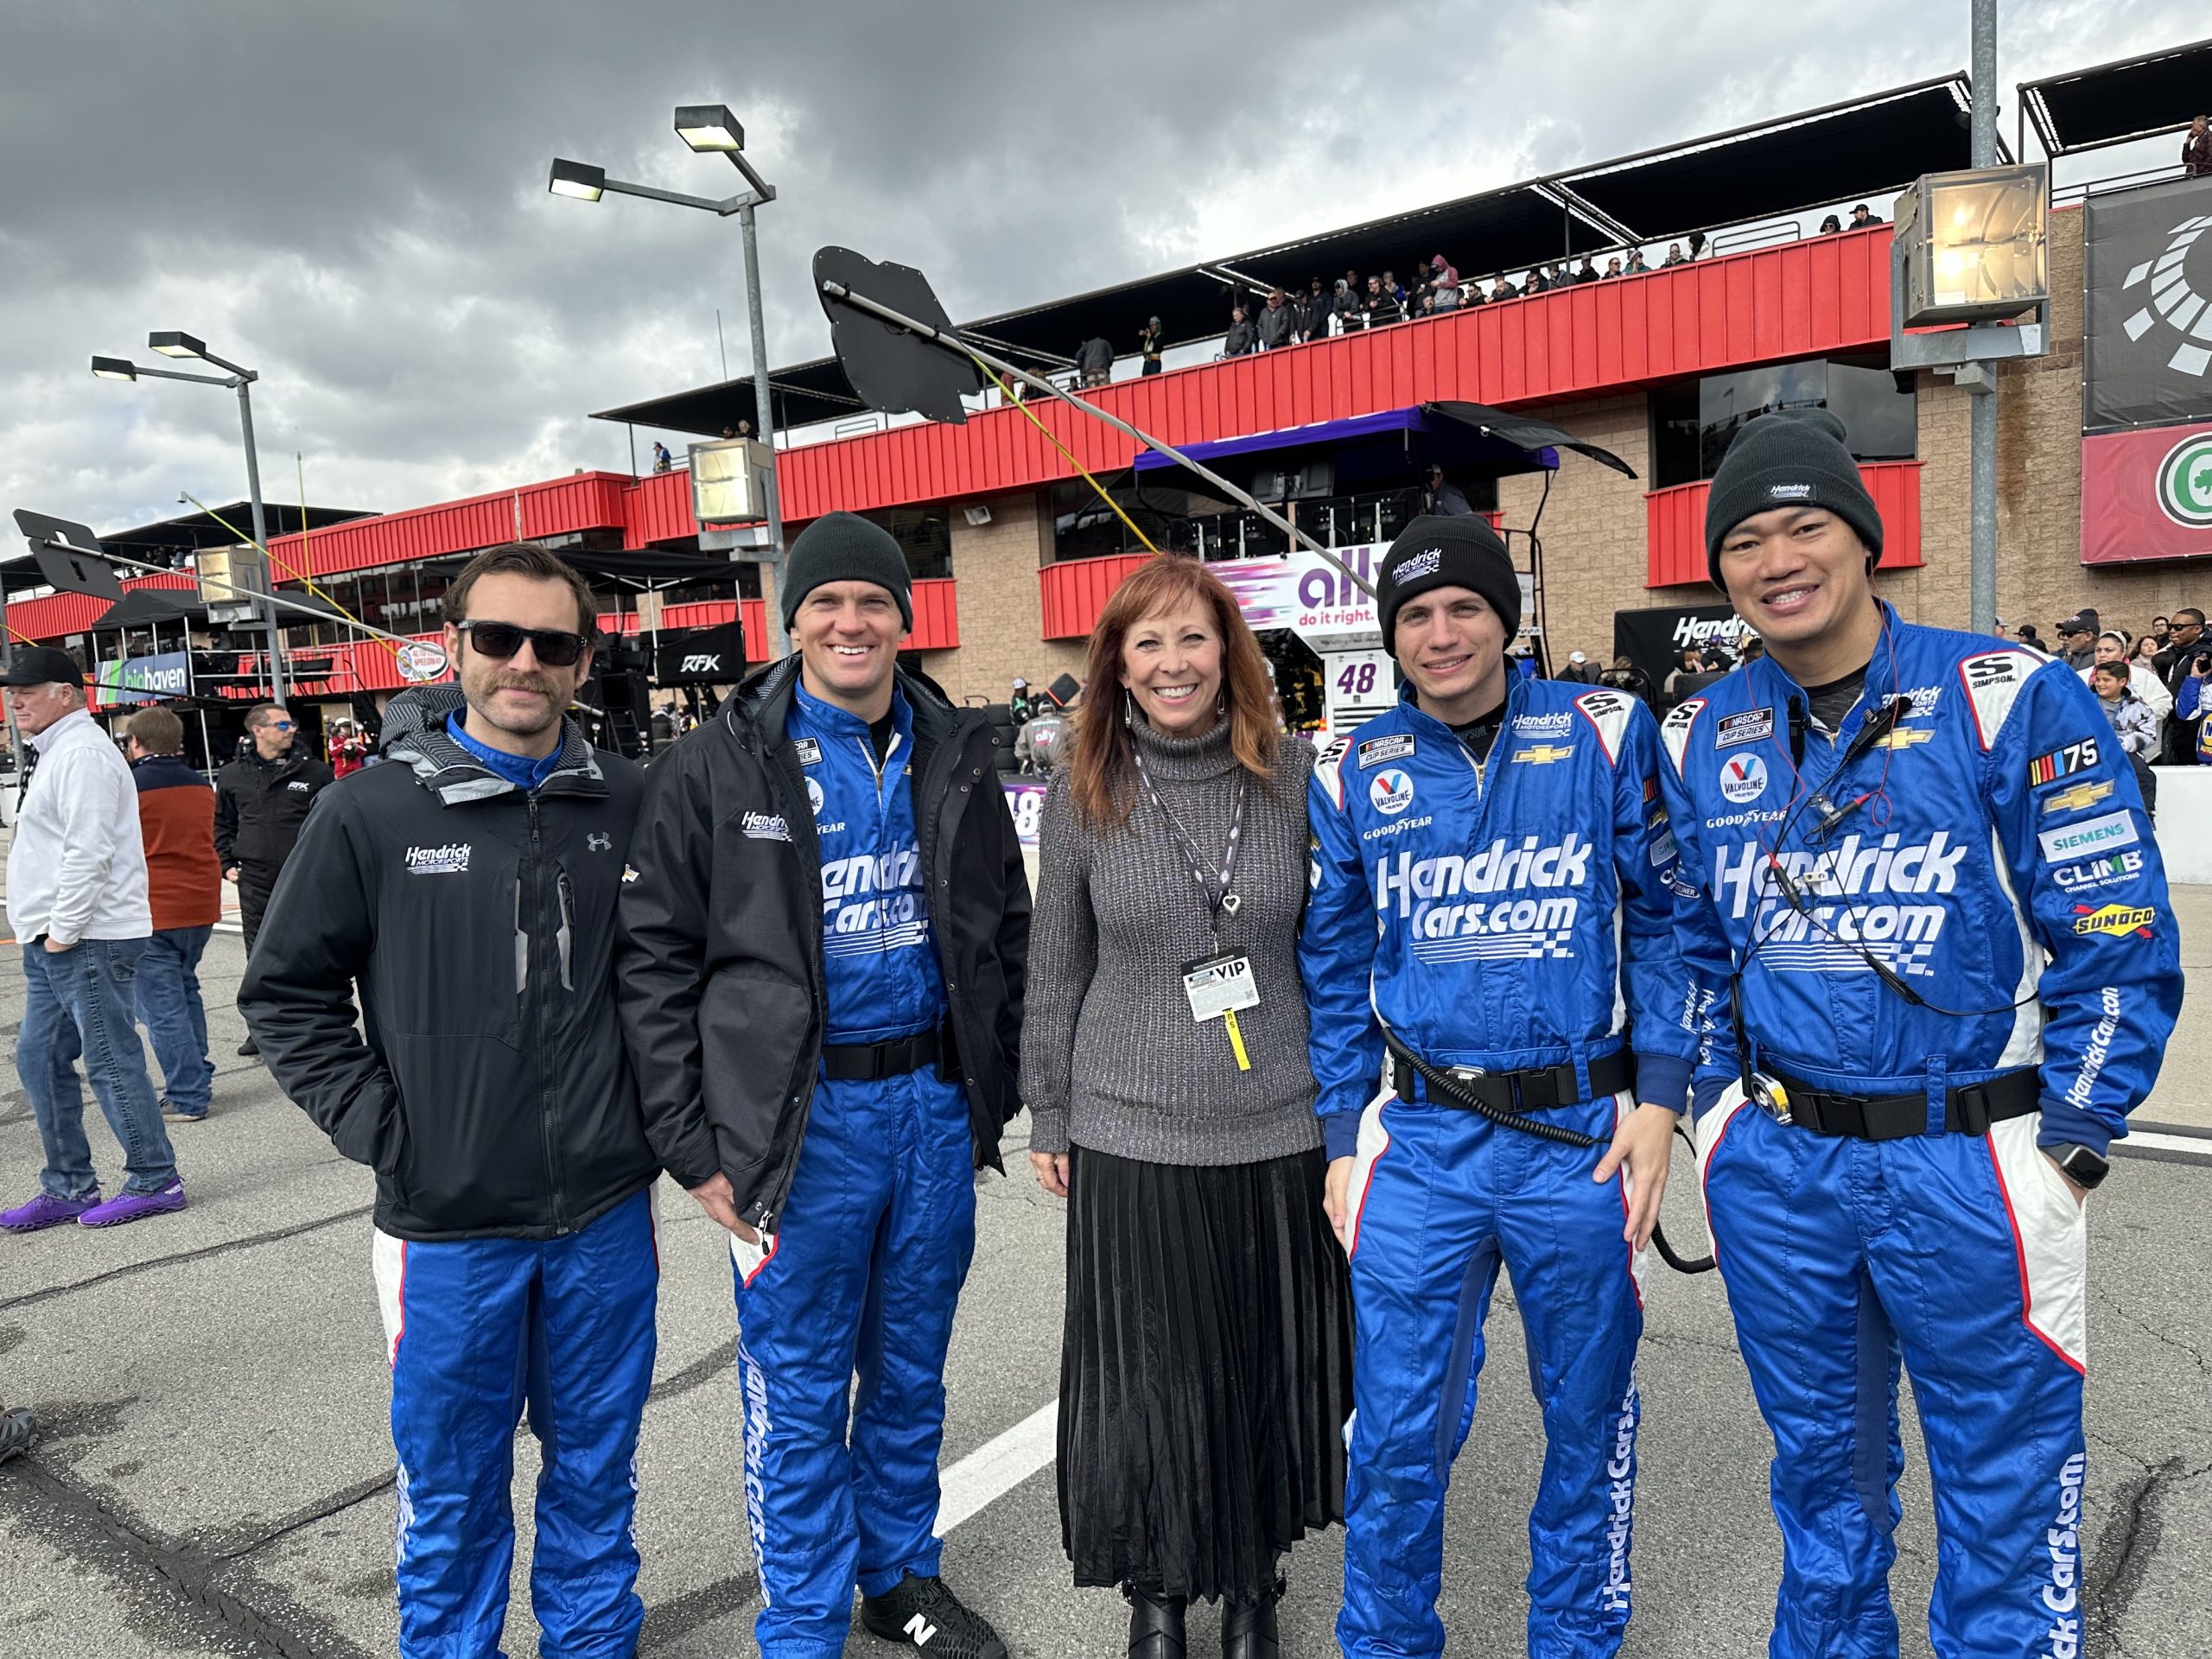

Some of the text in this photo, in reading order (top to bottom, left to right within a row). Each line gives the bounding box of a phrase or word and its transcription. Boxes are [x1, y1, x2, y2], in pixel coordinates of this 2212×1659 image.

[1770, 484, 1810, 495] Hendrick
[1391, 548, 1441, 580] Hendrick
[1299, 547, 1382, 609] all
[1299, 609, 1374, 626] do it right.
[680, 654, 720, 672] RFK
[124, 665, 185, 690] biohaven
[1337, 663, 1376, 694] 48
[1973, 675, 2012, 689] SIMPSON
[1511, 712, 1573, 729] Hendrick
[1592, 705, 1624, 718] SIMPSON
[1732, 712, 1764, 726] NASCAR
[1036, 730, 1055, 743] ally
[1374, 737, 1404, 749] NASCAR
[1723, 726, 1764, 741] CUP SERIES
[1366, 746, 1406, 761] CUP SERIES
[2063, 738, 2098, 772] 75
[1724, 778, 1764, 794] VALVOLINE
[1375, 790, 1411, 808] VALVOLINE
[1363, 816, 1433, 840] GOODYEAR
[1707, 809, 1787, 828] GOODYEAR
[2053, 823, 2125, 850] SIEMENS
[405, 843, 471, 866] Hendrick
[416, 857, 468, 866] MOTORSPORTS
[821, 841, 923, 899] endri
[1377, 833, 1592, 918] Hendrick
[1714, 831, 1967, 918] Hendrick
[2053, 851, 2143, 886] CLIMB
[2064, 872, 2140, 893] CHANNEL SOLUTIONS
[1412, 897, 1577, 939] Cars.com
[1753, 905, 1946, 943] Cars.com
[2078, 910, 2152, 933] SUNOCO
[1215, 961, 1245, 980] VIP
[903, 1612, 938, 1647] N
